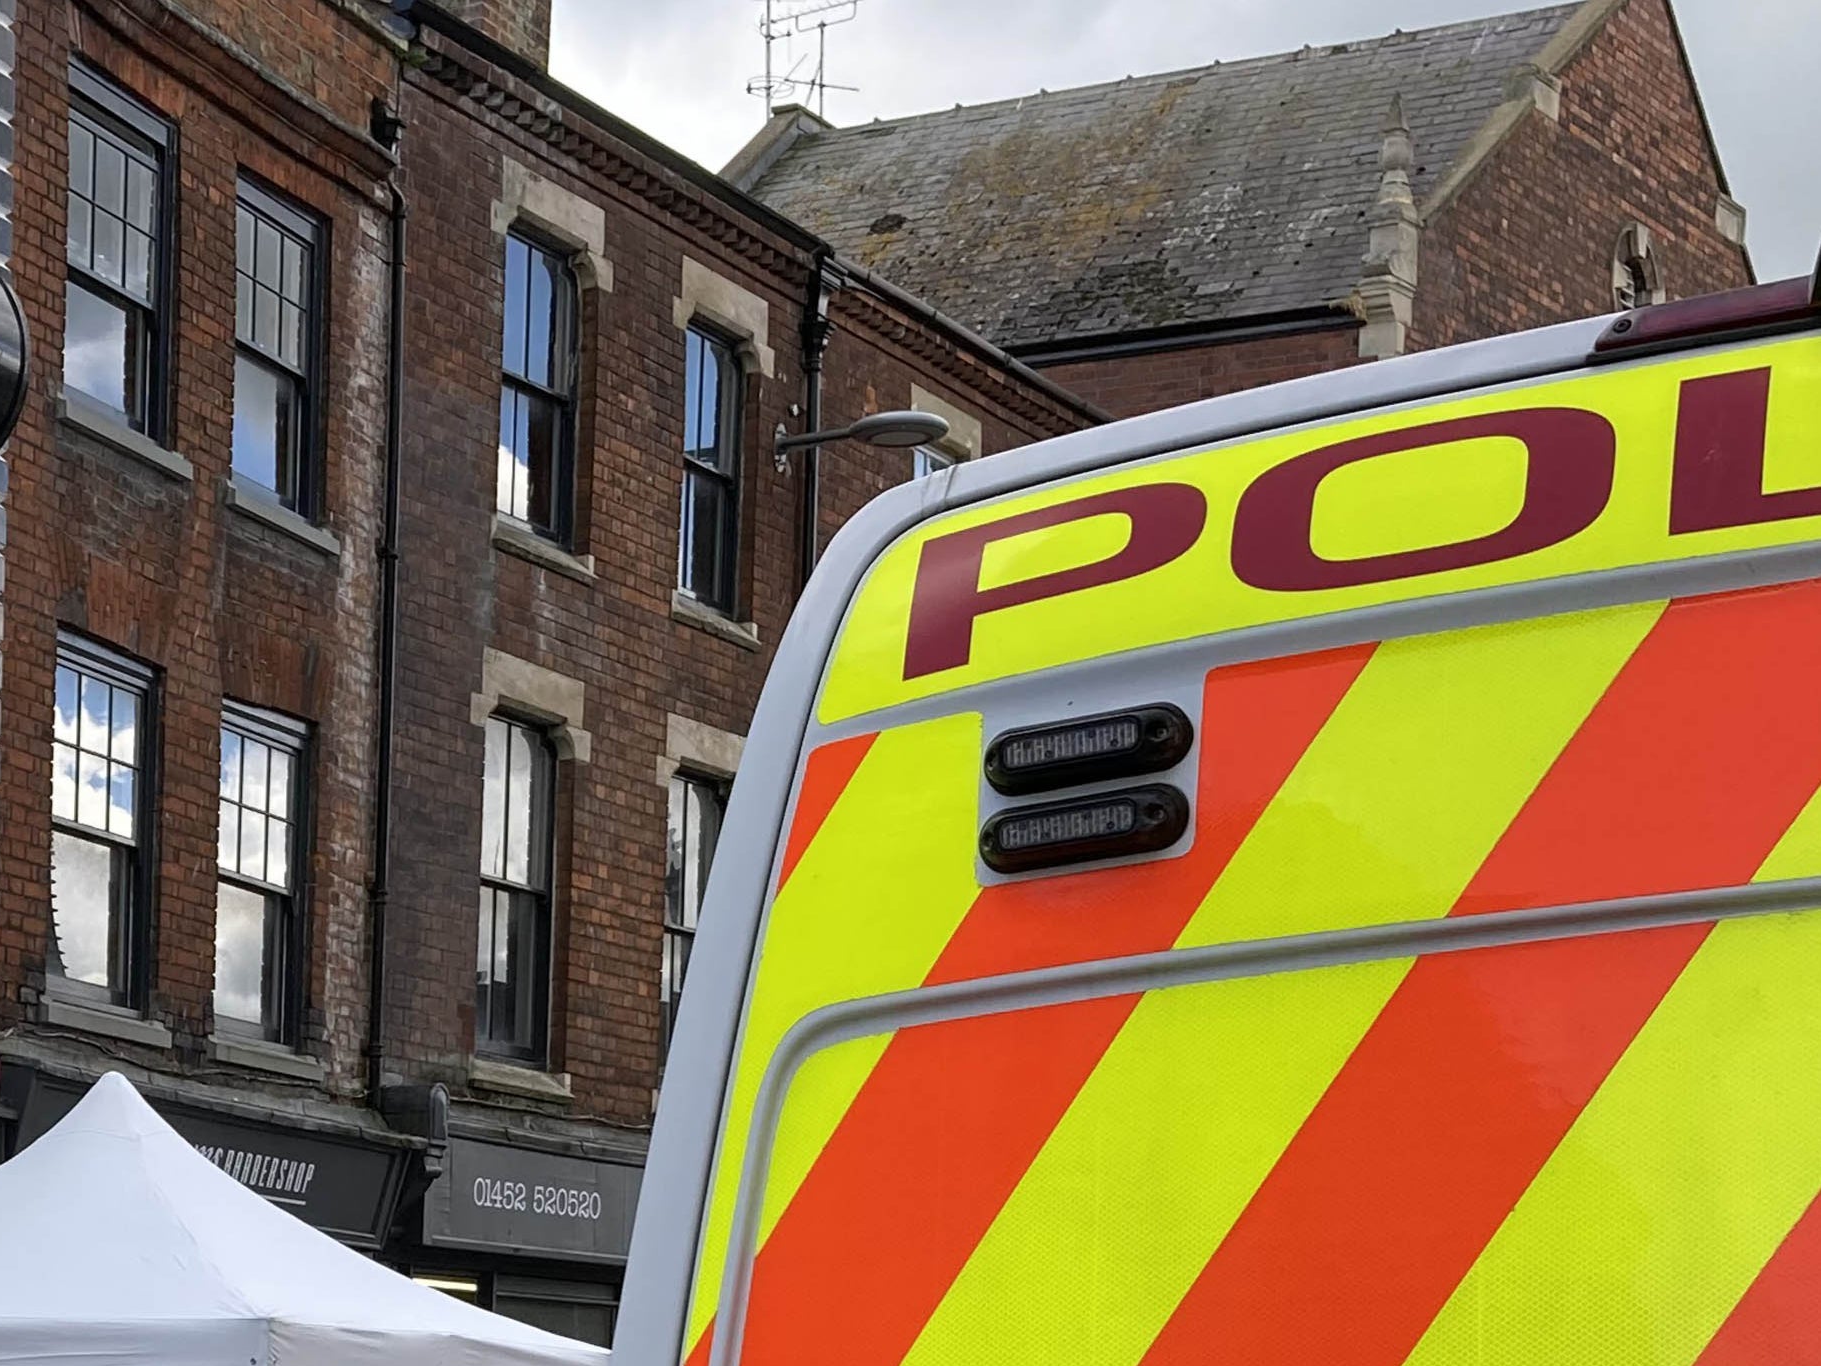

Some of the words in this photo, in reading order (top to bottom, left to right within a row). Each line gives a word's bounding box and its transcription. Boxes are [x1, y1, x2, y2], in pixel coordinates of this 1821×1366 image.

[902, 365, 1821, 682] POL
[223, 1149, 316, 1193] BARBERSHOP
[473, 1177, 527, 1211] 01452
[533, 1185, 602, 1220] 520520
